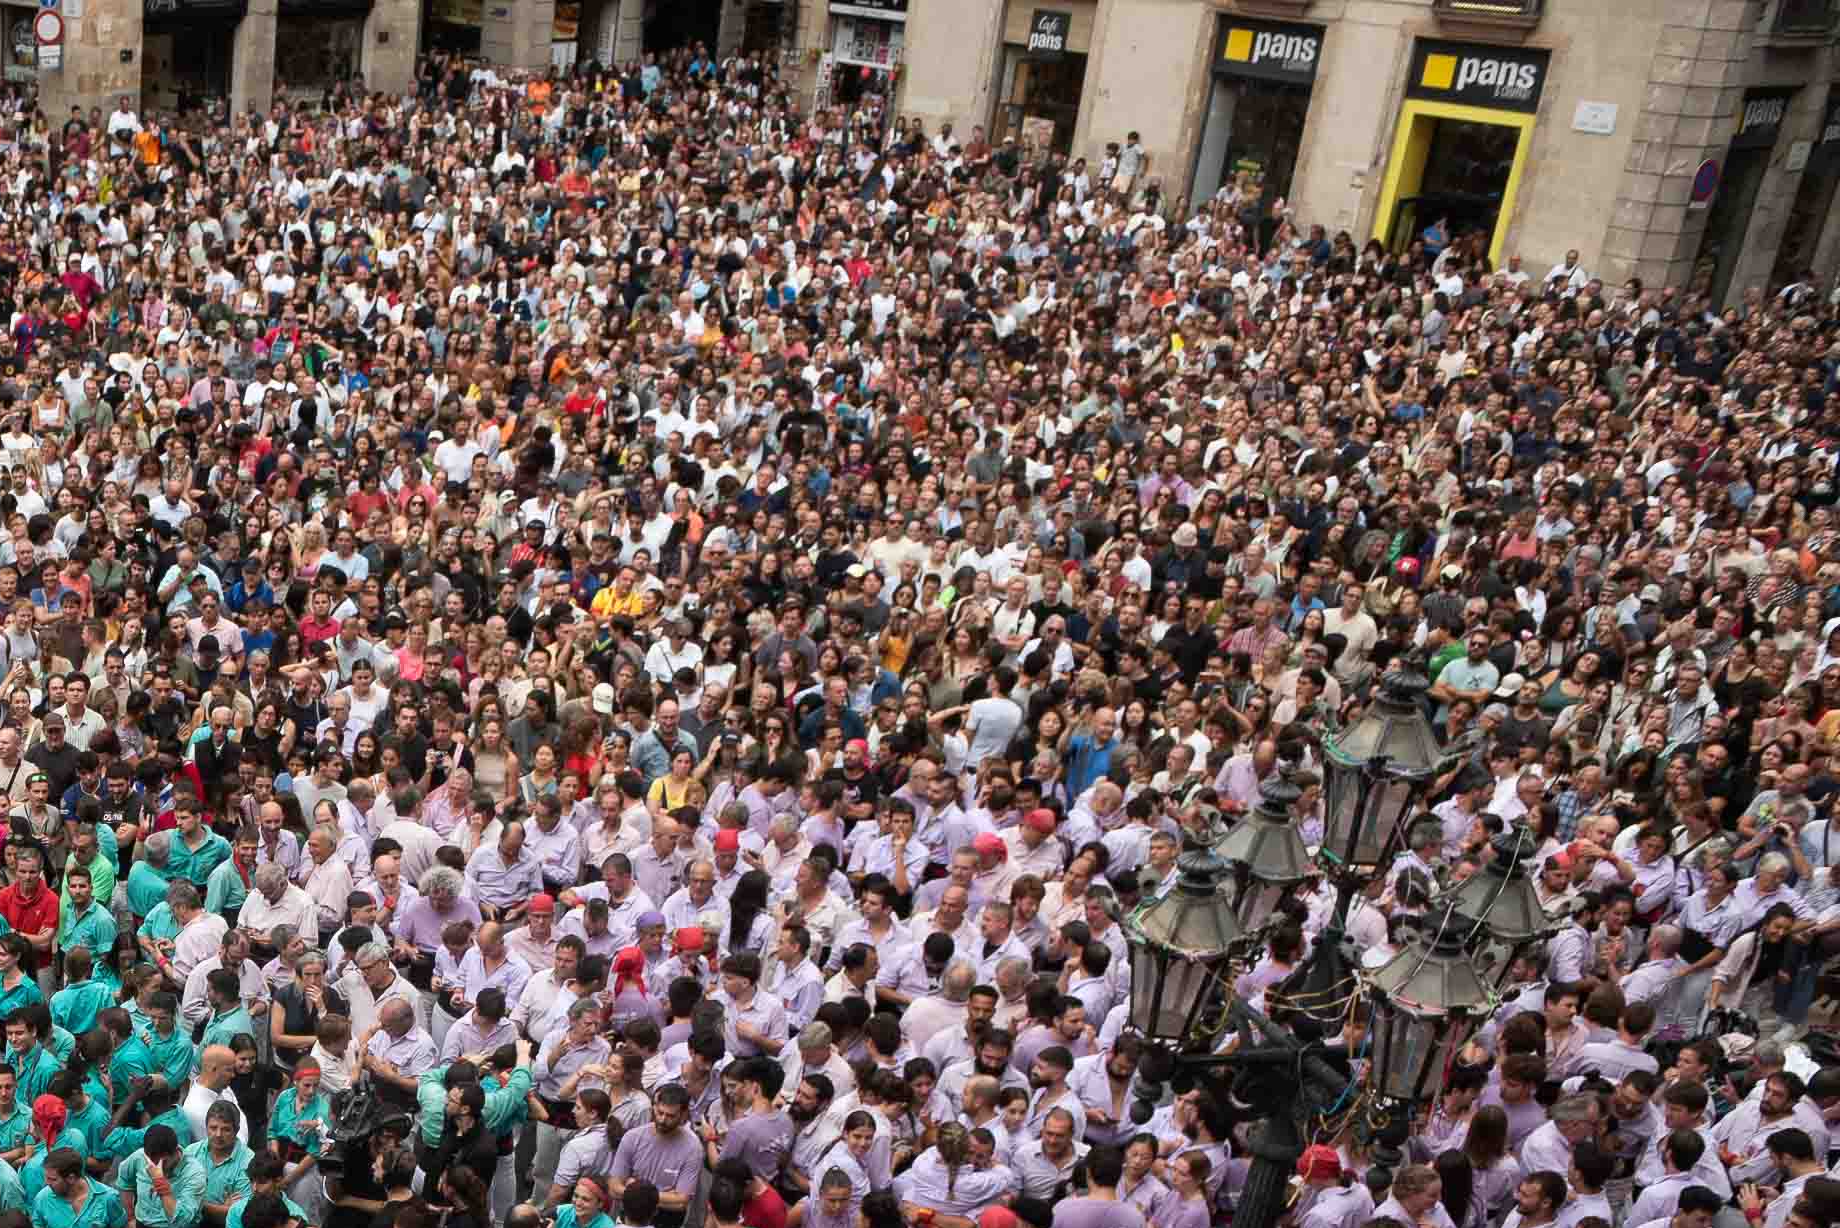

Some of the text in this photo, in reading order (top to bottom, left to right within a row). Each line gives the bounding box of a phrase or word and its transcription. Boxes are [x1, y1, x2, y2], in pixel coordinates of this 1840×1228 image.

[1028, 33, 1063, 52] pans
[1252, 31, 1318, 64] pans
[1456, 57, 1537, 91] pans
[1744, 97, 1785, 127] pans
